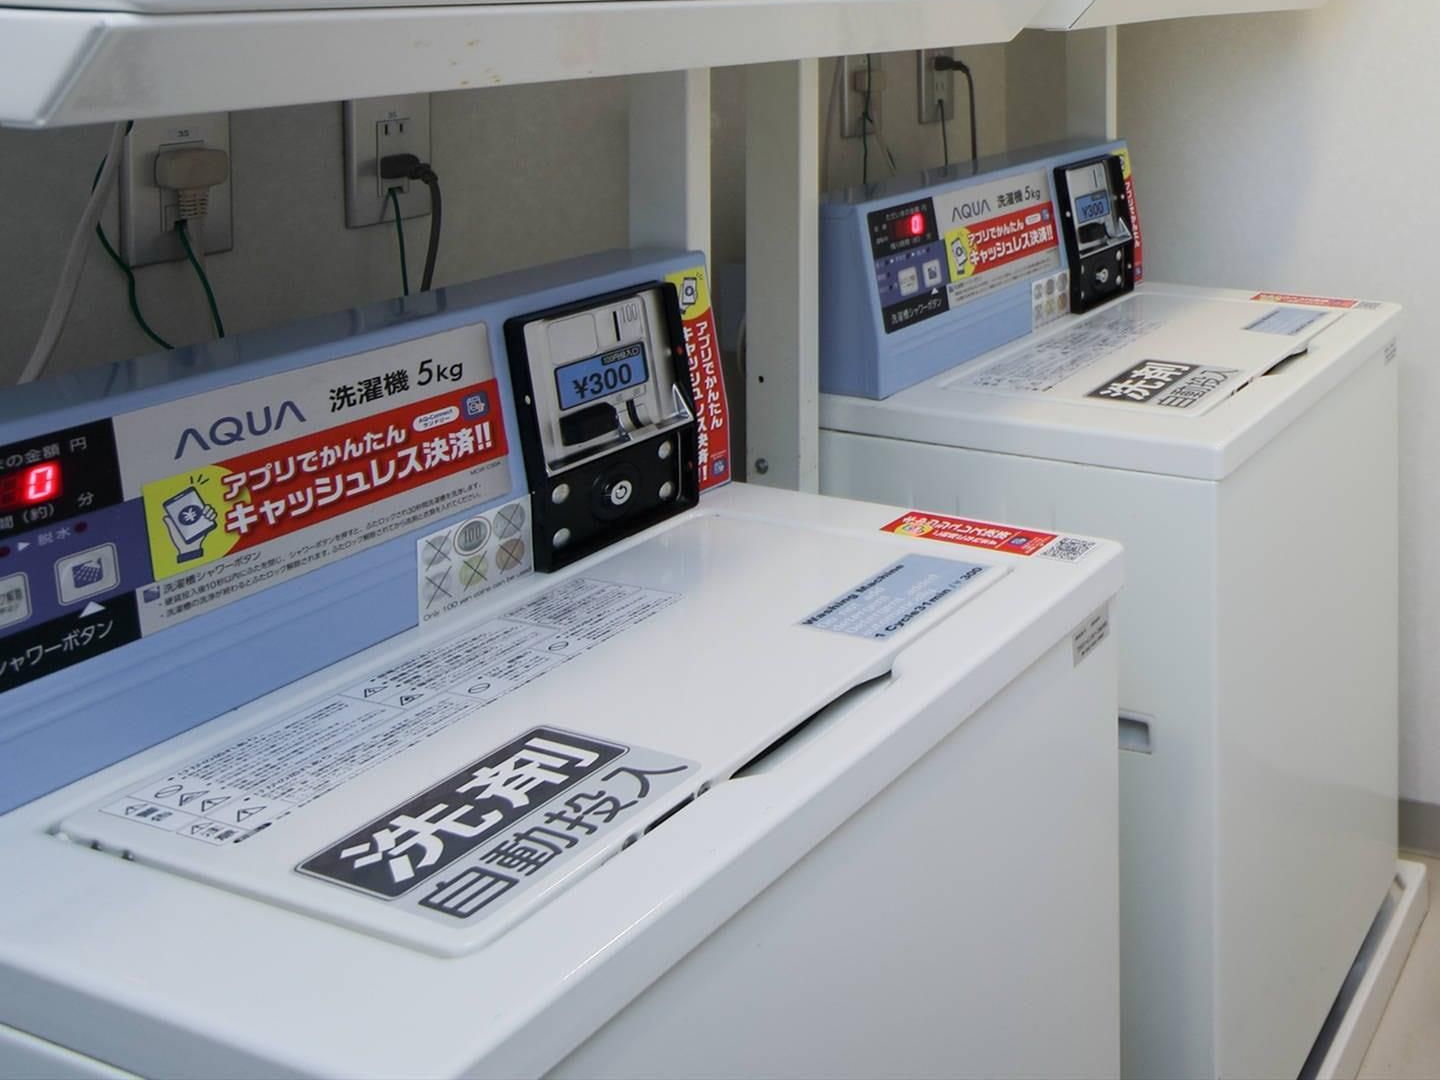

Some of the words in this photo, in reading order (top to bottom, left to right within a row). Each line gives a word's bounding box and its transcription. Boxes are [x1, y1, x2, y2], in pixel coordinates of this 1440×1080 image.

[952, 199, 991, 222] AQUA
[1025, 186, 1041, 201] 5kg
[1082, 200, 1105, 218] ¥300
[968, 220, 1024, 246] アプリでかんたん
[969, 224, 1054, 265] キャッシュレス決済!!
[328, 368, 411, 413] 洗濯機
[416, 358, 464, 388] 5kg
[573, 363, 632, 399] ¥300
[696, 321, 723, 429] アプリでかんたん
[1100, 359, 1191, 401] 洗剤
[70, 436, 88, 452] 円
[174, 399, 307, 460] AQUA
[28, 465, 54, 500] 0
[223, 427, 406, 499] アプリでかんたん
[225, 421, 494, 535] キャッシュレス決済!!
[78, 491, 94, 508] 分
[163, 551, 262, 594] 洗濯槽シャワーボタン
[340, 736, 602, 884] 洗剤
[419, 763, 688, 920] 自動投入
